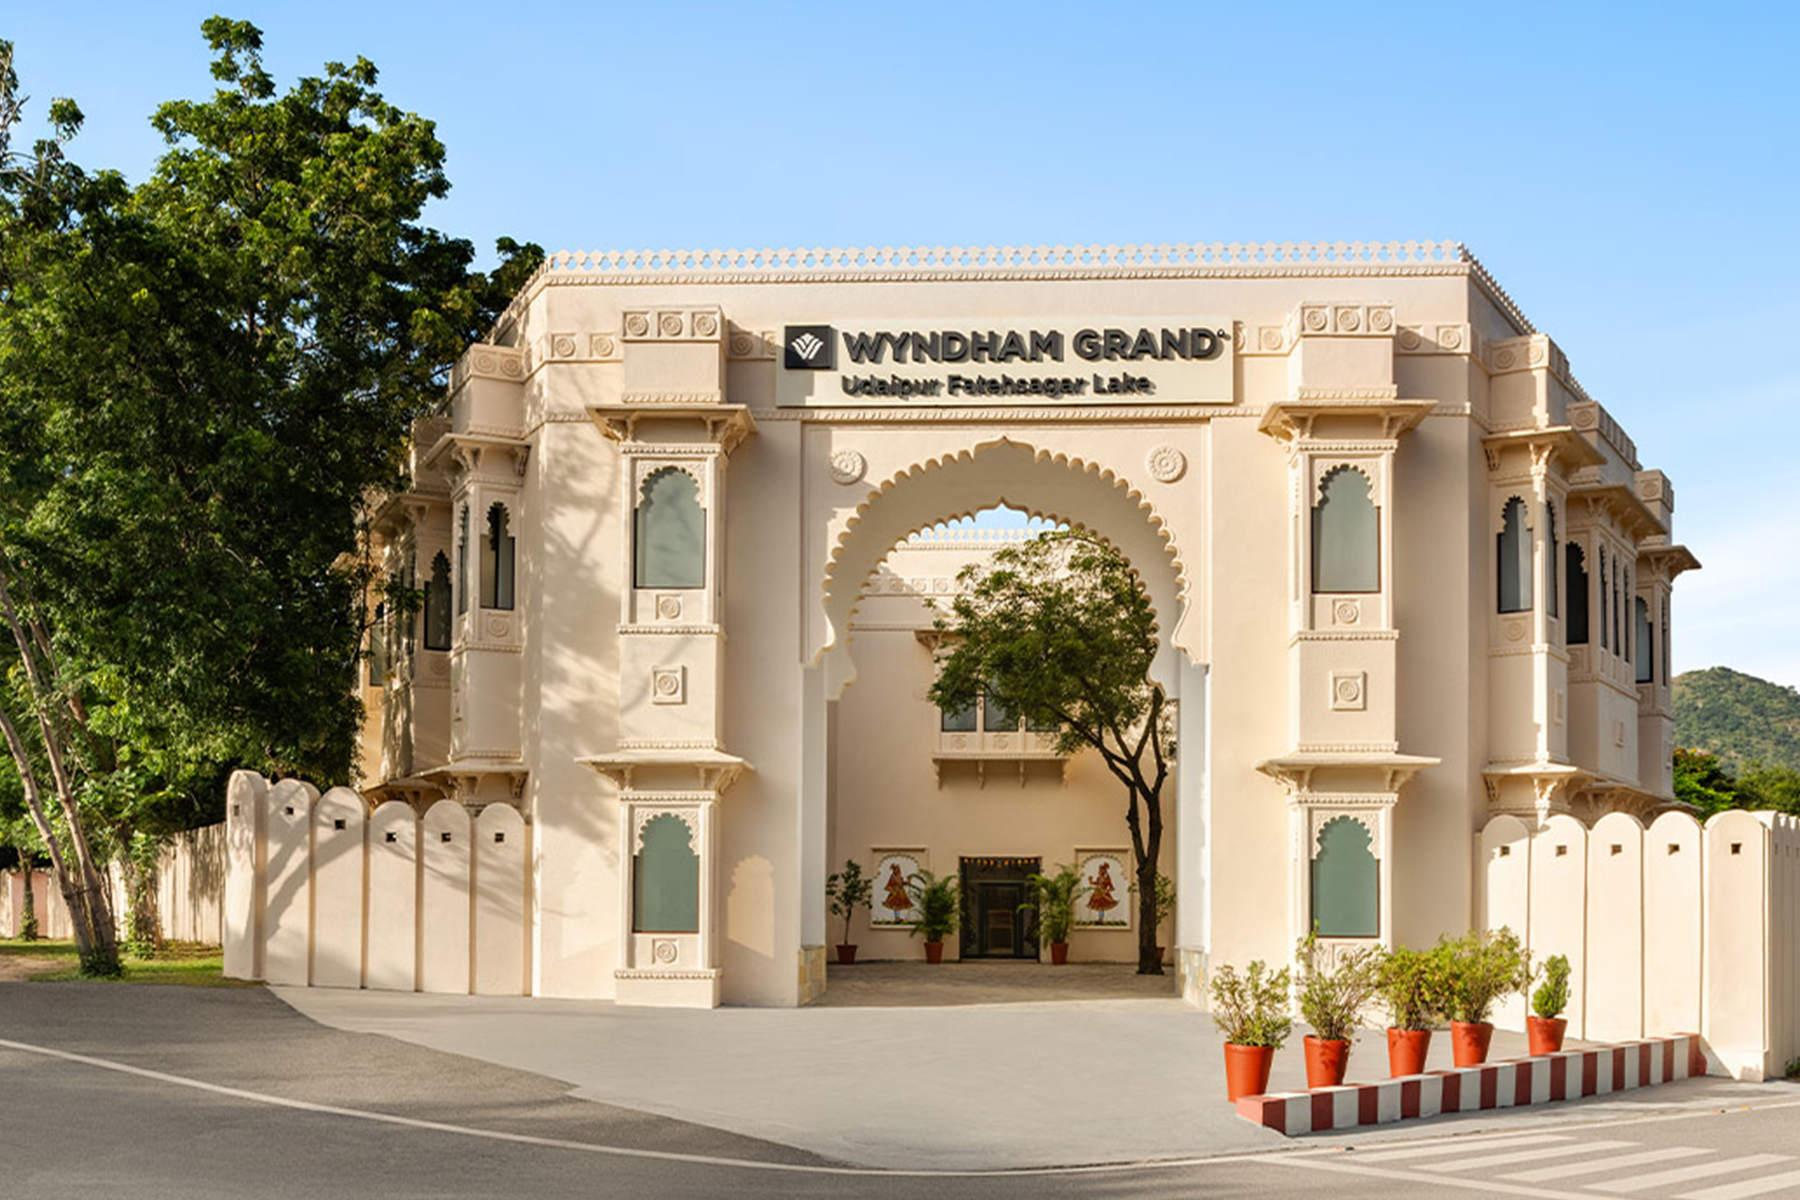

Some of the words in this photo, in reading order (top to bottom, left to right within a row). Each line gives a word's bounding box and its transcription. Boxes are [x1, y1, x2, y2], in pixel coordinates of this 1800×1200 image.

[843, 330, 1062, 363] WYNDHAM
[1073, 328, 1220, 361] GRAND
[842, 375, 937, 400] Udaipur
[947, 374, 1084, 397] Fatehsagar
[1093, 373, 1149, 394] Lake
